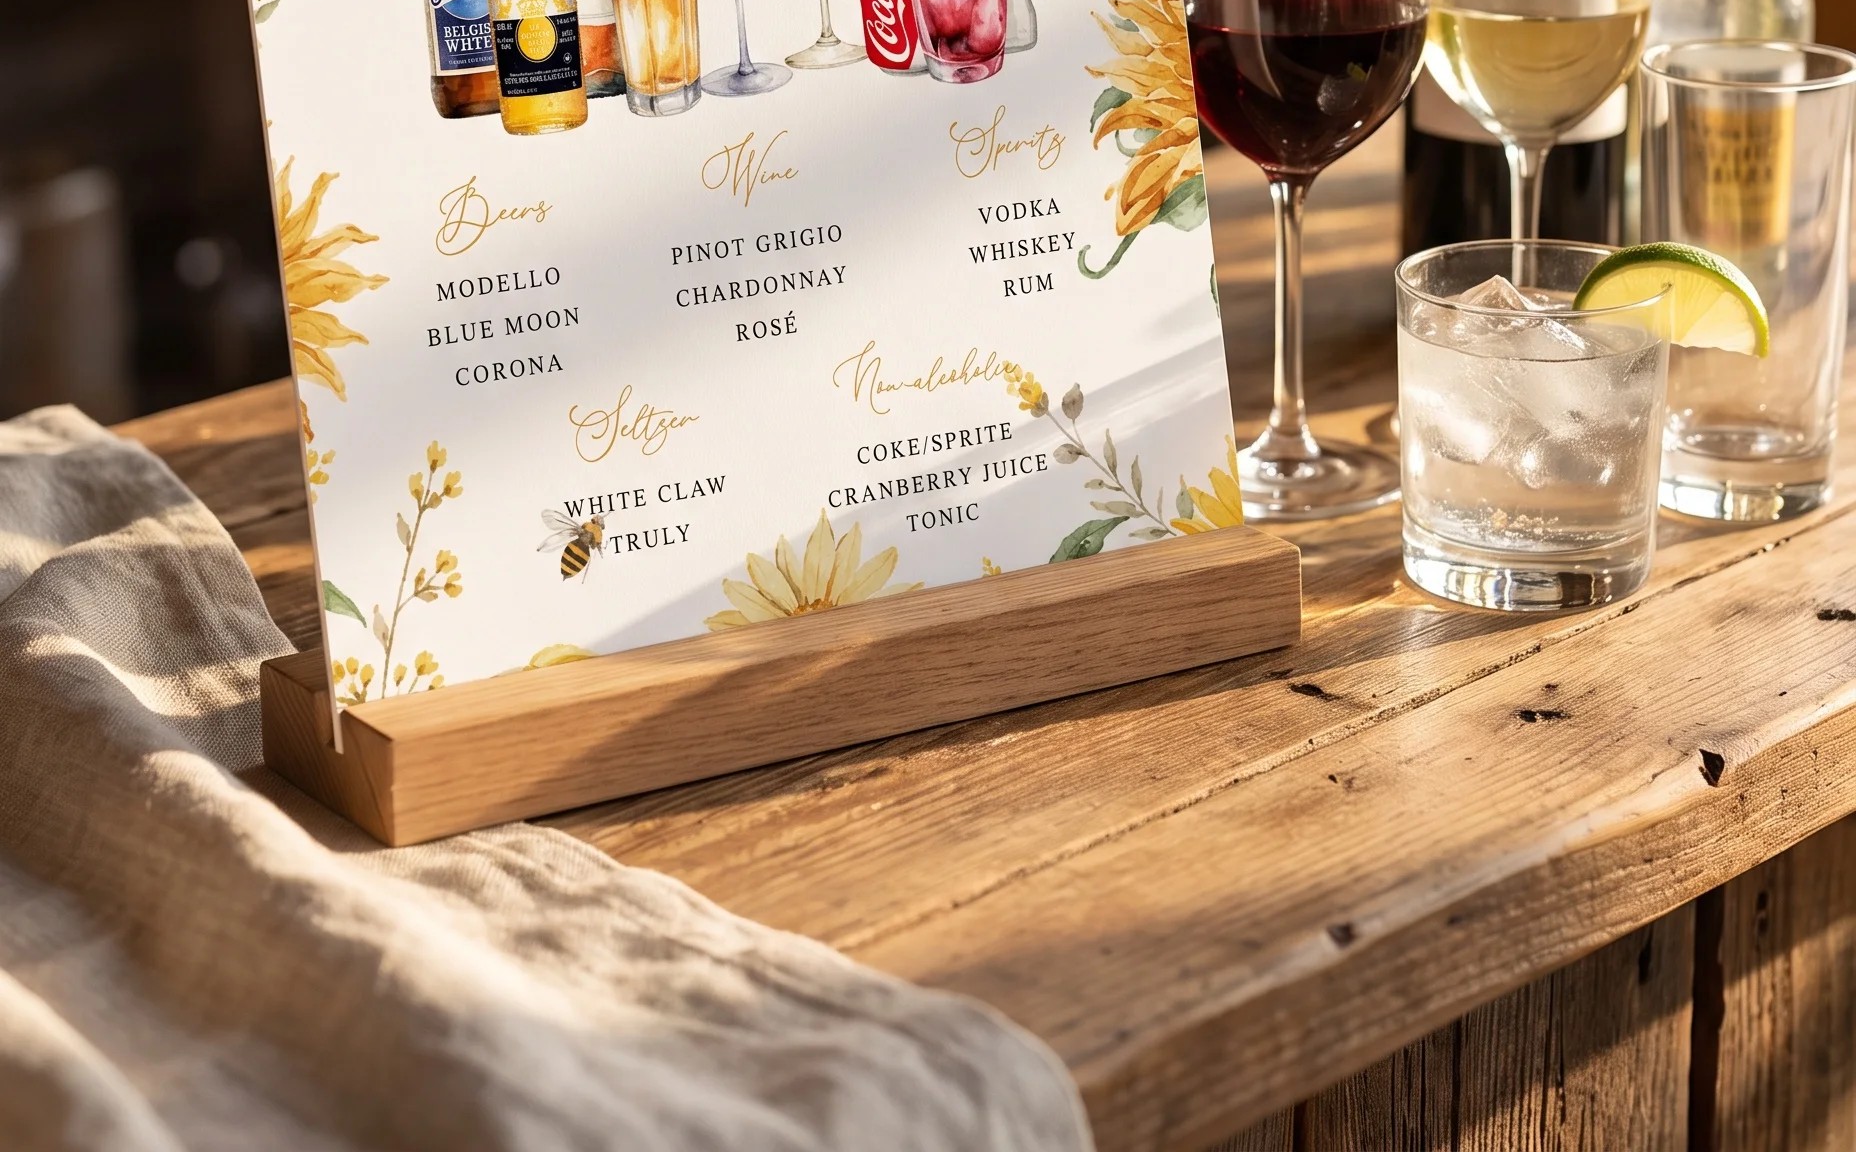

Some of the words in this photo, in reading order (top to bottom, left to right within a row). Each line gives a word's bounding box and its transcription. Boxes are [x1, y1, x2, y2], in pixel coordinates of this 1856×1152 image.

[444, 23, 491, 38] BELGIS
[949, 104, 1066, 179] Spirits
[701, 130, 799, 208] Wine
[435, 175, 553, 257] Beers
[977, 197, 1061, 225] VODKA
[670, 237, 745, 266] PINOT
[755, 224, 842, 253] GRIGIO
[968, 231, 1076, 264] WHISKEY
[435, 266, 561, 302] MODELLO
[675, 265, 848, 307] CHARDONNAY
[1003, 272, 1055, 298] RUM
[426, 319, 494, 348] BLUE
[504, 306, 579, 336] MOON
[735, 310, 798, 342] ROSÉ
[455, 353, 564, 386] CORONA
[568, 384, 700, 463] Seltzer
[856, 421, 1013, 465] COKE/SPRITE
[563, 488, 647, 518] WHITE
[657, 475, 726, 503] CLAW
[828, 466, 972, 508] CRANBERRY
[982, 453, 1048, 483] JUICE
[905, 502, 980, 532] TONIC
[609, 523, 690, 555] TRULY
